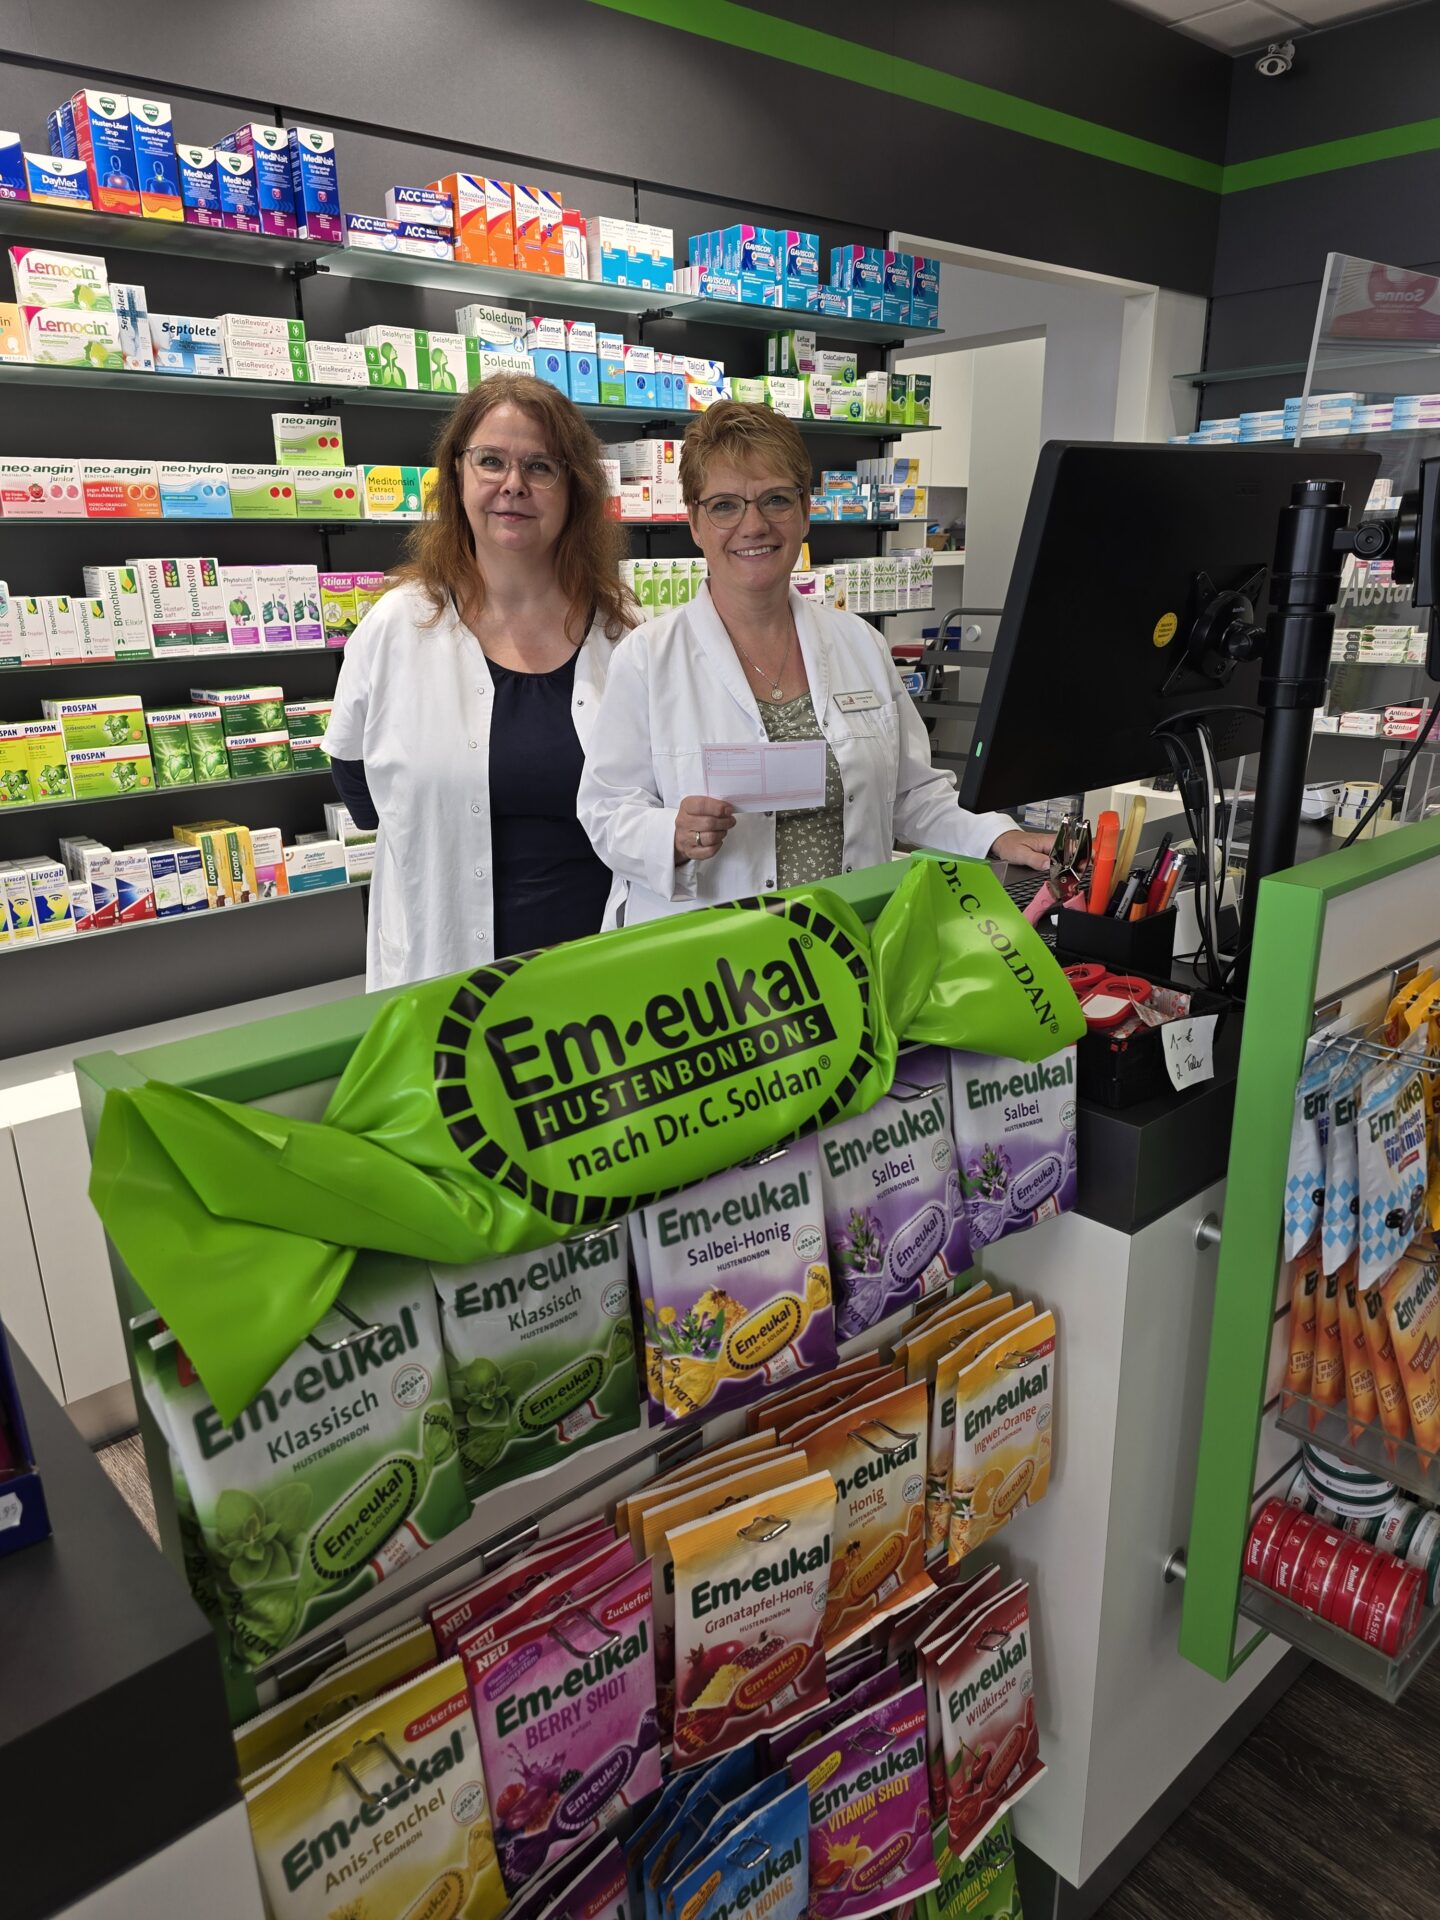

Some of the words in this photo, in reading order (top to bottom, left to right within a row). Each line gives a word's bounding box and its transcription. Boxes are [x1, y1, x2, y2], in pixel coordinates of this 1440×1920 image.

[136, 125, 171, 137] Husten-Sirup
[42, 175, 77, 188] DayMed
[399, 190, 421, 202] ACC
[351, 218, 373, 230] ACC
[405, 225, 425, 237] ACC
[746, 243, 772, 254] GAVISCON
[790, 248, 815, 258] GAVISCON
[26, 258, 95, 280] Lemocin
[702, 276, 731, 286] GAVISCON
[856, 262, 878, 272] GAVISCON
[887, 266, 908, 276] GAVISCON
[118, 289, 128, 330] Septolete
[479, 309, 523, 325] Soledum
[37, 317, 108, 335] Lemocin
[162, 322, 216, 337] Septolete
[539, 324, 561, 334] Silomat
[572, 328, 593, 338] Silomat
[601, 341, 622, 350] Silomat
[630, 350, 649, 359] Silomat
[484, 354, 531, 370] Soledum
[688, 360, 705, 371] Talcid
[695, 387, 713, 396] Talcid
[771, 380, 785, 388] Lefax
[369, 478, 415, 486] Meditonsin
[148, 564, 163, 619] Bronchostop
[186, 563, 201, 617] Bronchostop
[322, 577, 352, 587] Stilaxx
[107, 572, 123, 627] Bronchicum
[16, 601, 26, 636] Bronchicum
[48, 600, 57, 634] Bronchicum
[79, 603, 91, 643] Bronchicum
[62, 703, 97, 713] PROSPAN
[225, 693, 251, 701] PROSPAN
[25, 725, 56, 733] PROSPAN
[152, 713, 181, 722] PROSPAN
[189, 710, 217, 719] PROSPAN
[231, 737, 256, 745] PROSPAN
[71, 751, 106, 761] PROSPAN
[31, 868, 64, 881] Livocab
[209, 854, 217, 884] Lorano
[233, 851, 242, 880] Lorano
[960, 894, 980, 920] C.
[534, 1014, 823, 1137] HUSTENBONBONS
[1176, 1064, 1183, 1079] 2
[1004, 1100, 1040, 1122] Salbei
[1004, 1118, 1043, 1133] HUSTENBONBON
[567, 1124, 649, 1181] nach
[657, 1107, 700, 1148] Dr.
[872, 1154, 915, 1188] Salbei
[1016, 1163, 1056, 1200] Em-eukal
[876, 1176, 920, 1201] HUSTENBONBON
[688, 1222, 791, 1266] Salbei-Honig
[896, 1213, 939, 1268] Em-eukal
[716, 1249, 770, 1272] HUSTENBONBON
[508, 1286, 582, 1332] Klassisch
[520, 1311, 578, 1342] HUSTENBONBON
[734, 1305, 792, 1356] Em-eukal
[529, 1363, 595, 1417] Em-eukal
[964, 1364, 1048, 1442] Em-eukal
[266, 1390, 380, 1464] Klassisch
[974, 1405, 1037, 1456] Ingwer-Orange
[292, 1422, 370, 1472] HUSTENBONBON
[849, 1486, 884, 1517] Honig
[997, 1466, 1031, 1508] Em-eukal
[322, 1468, 405, 1558] Em-eukal
[692, 1534, 830, 1619] Em-eukal
[1280, 1561, 1288, 1588] Pulmoll
[1346, 1564, 1359, 1592] Pulmoll
[606, 1588, 652, 1620] Zuckerfrei
[704, 1580, 814, 1635] Granatapfel-Honig
[440, 1603, 472, 1638] NEU
[739, 1608, 791, 1633] HUSTENBONBON
[1368, 1602, 1384, 1642] CLASSIC
[476, 1642, 509, 1674] NEU
[744, 1652, 798, 1698] Em-eukal
[948, 1632, 1027, 1724] Em-eukal
[410, 1695, 468, 1737] Zuckerfrei
[526, 1700, 582, 1750] BERRY
[586, 1672, 628, 1714] SHOT
[966, 1677, 1017, 1727] Wildkirsche
[566, 1753, 624, 1817] Em-eukal
[810, 1737, 924, 1825] Em-eukal
[827, 1792, 876, 1834] VITAMIN
[878, 1775, 910, 1804] SHOT
[324, 1788, 446, 1894] Anis-Fenchel
[358, 1830, 423, 1884] HUSTENBONBON
[859, 1838, 904, 1883] Em-eukal
